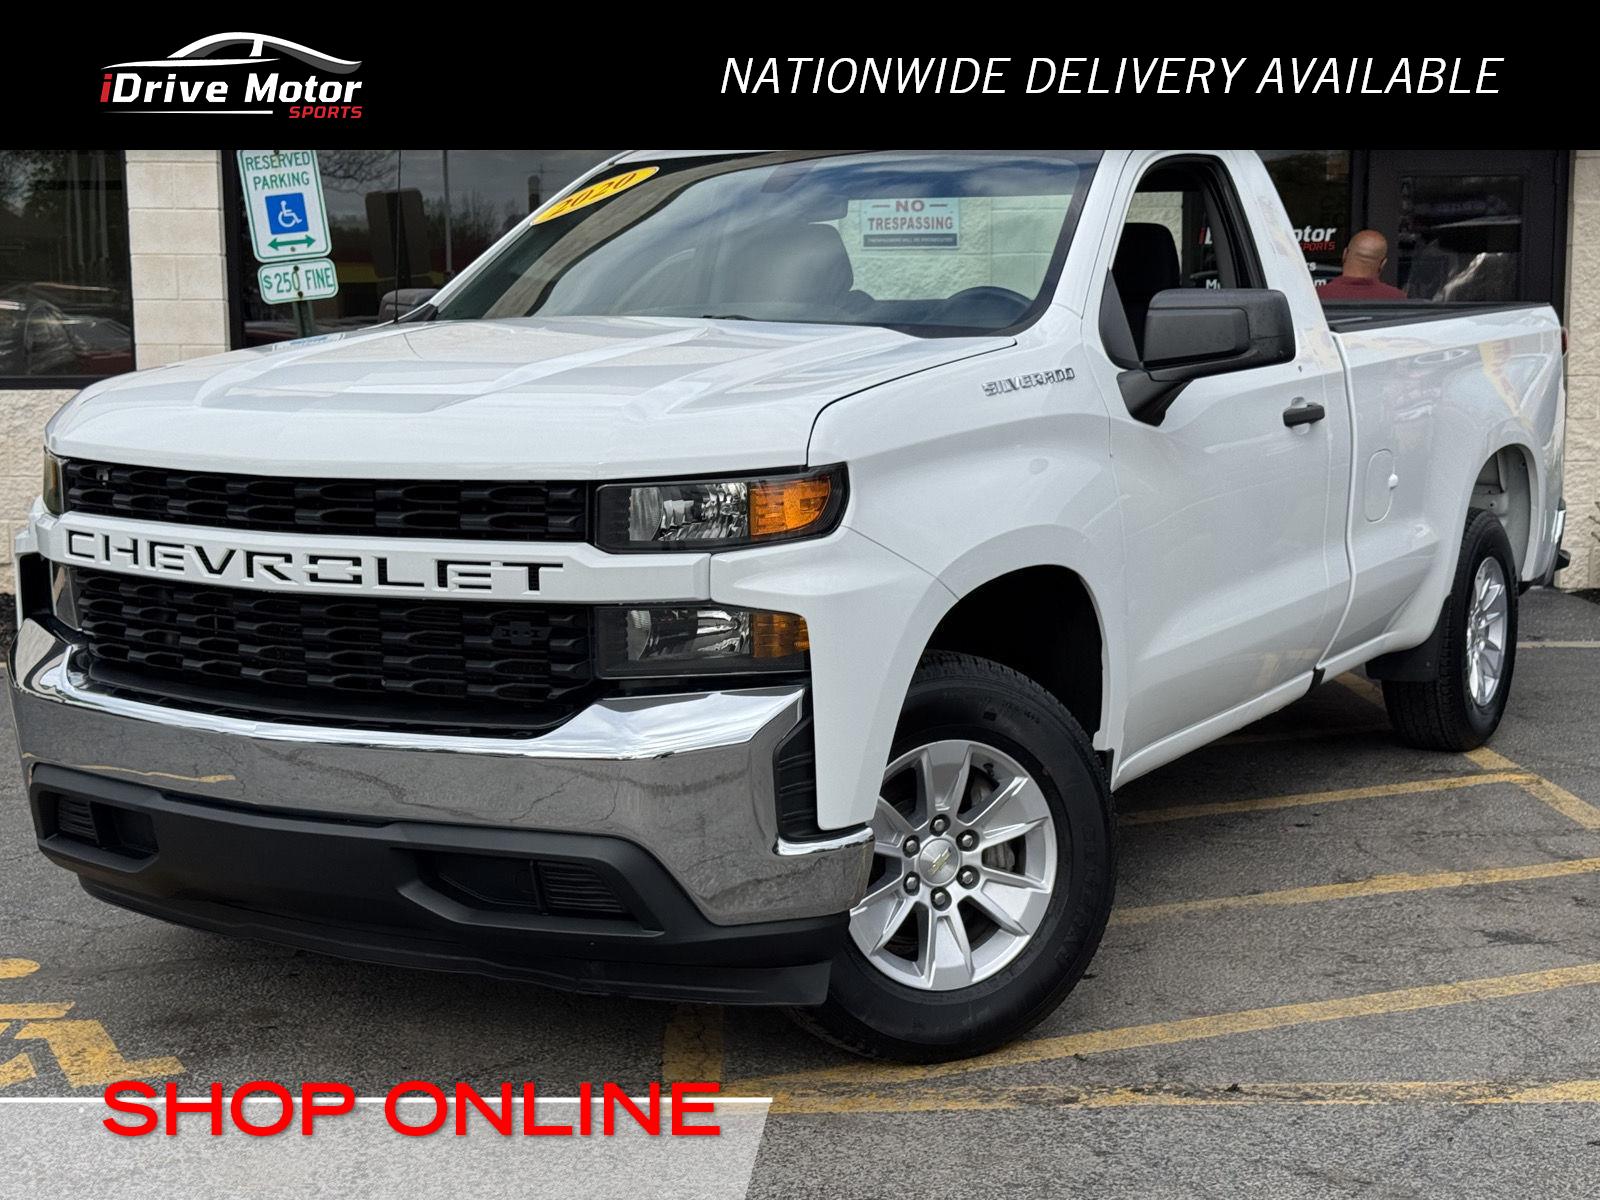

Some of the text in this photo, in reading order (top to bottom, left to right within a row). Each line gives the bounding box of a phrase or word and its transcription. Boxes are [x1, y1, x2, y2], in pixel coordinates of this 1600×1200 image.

[245, 151, 311, 171] RESERVED
[253, 171, 310, 191] PARKING
[546, 172, 637, 218] 2020
[895, 200, 925, 212] NO
[867, 215, 953, 231] TRESPASSING
[1294, 225, 1337, 243] otor
[305, 267, 335, 290] FINE
[982, 366, 1076, 397] SILVERADO
[66, 528, 565, 594] CHEVROLET
